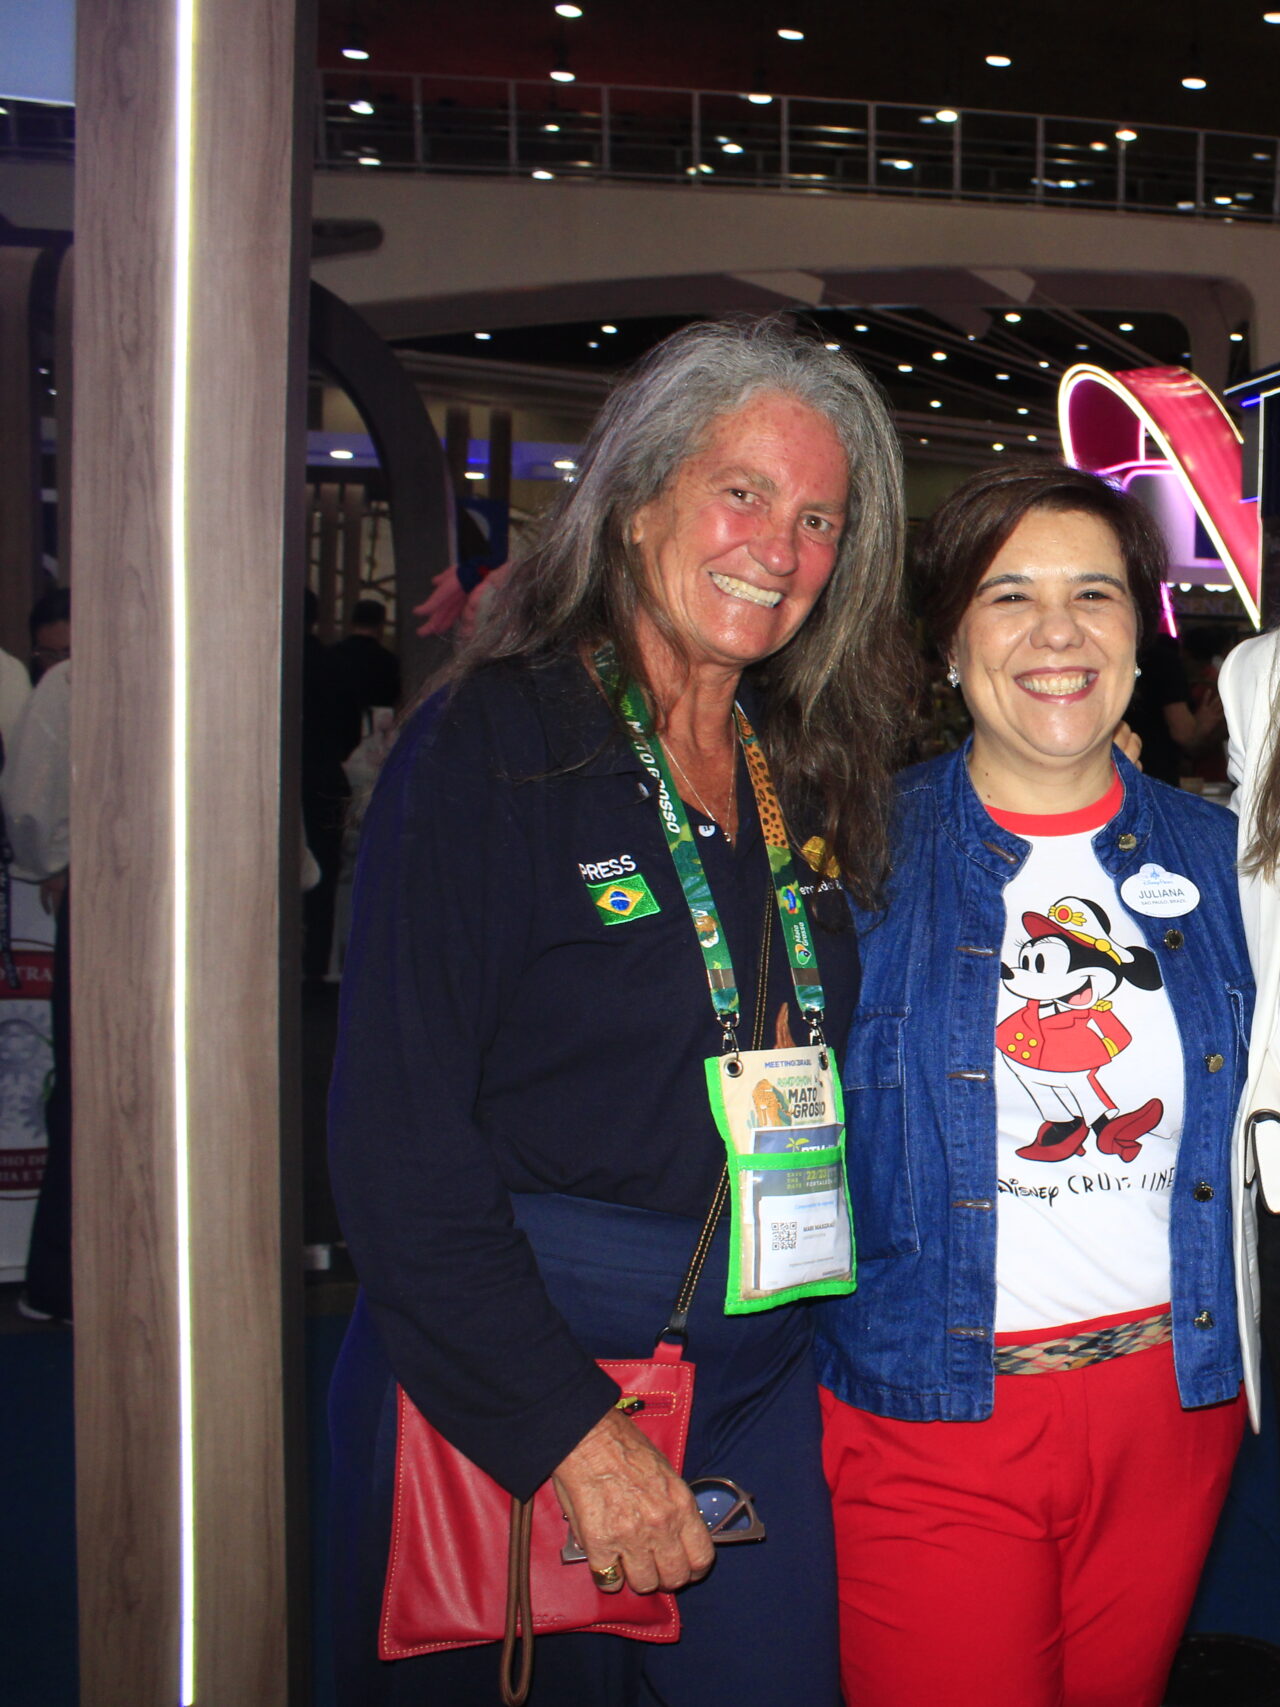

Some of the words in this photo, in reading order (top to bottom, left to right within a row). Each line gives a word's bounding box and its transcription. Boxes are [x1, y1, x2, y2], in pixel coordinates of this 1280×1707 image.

[578, 854, 637, 881] PRESS
[1138, 888, 1185, 899] JULIANA
[788, 1087, 818, 1105] MATO
